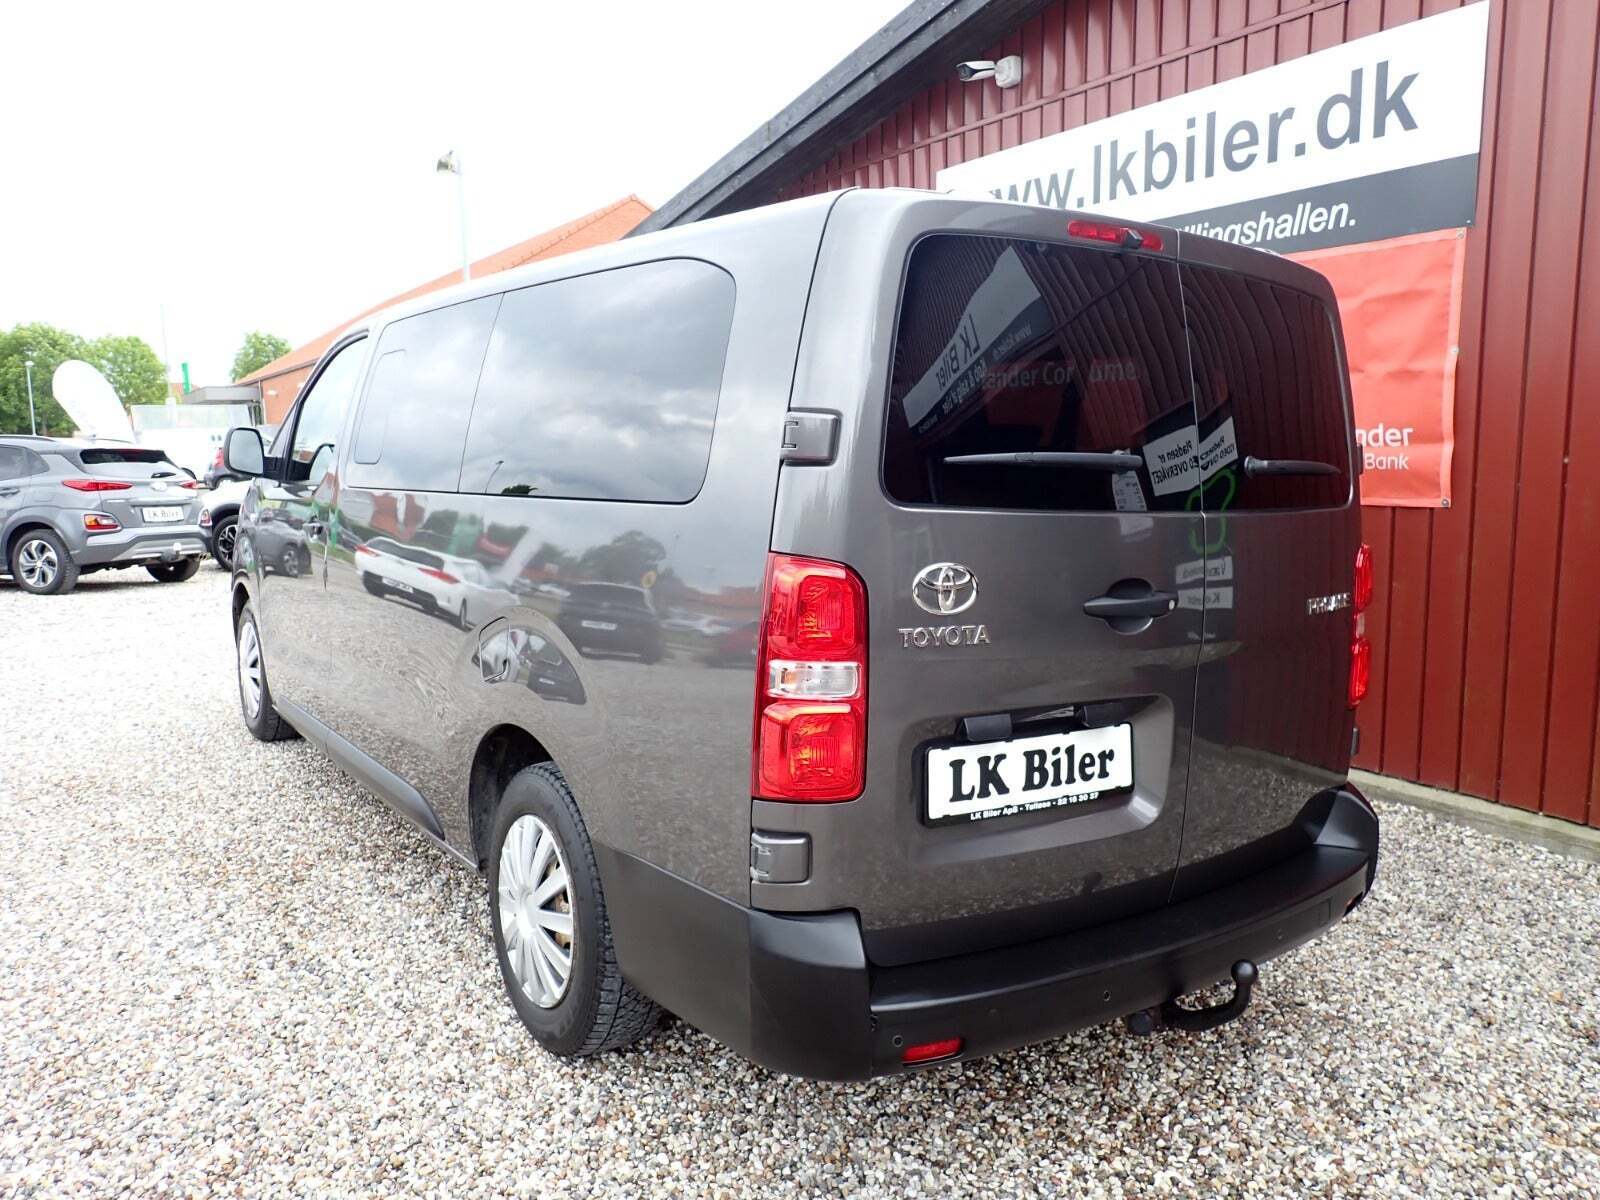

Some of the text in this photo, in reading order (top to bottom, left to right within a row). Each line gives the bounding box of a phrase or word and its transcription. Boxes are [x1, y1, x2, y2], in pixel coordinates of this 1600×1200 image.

[988, 60, 1419, 209] ww.lkbiler.dk
[1364, 453, 1408, 470] Bank
[898, 625, 991, 648] TOYOTA
[949, 744, 1115, 802] LK Biler
[970, 811, 981, 820] LK
